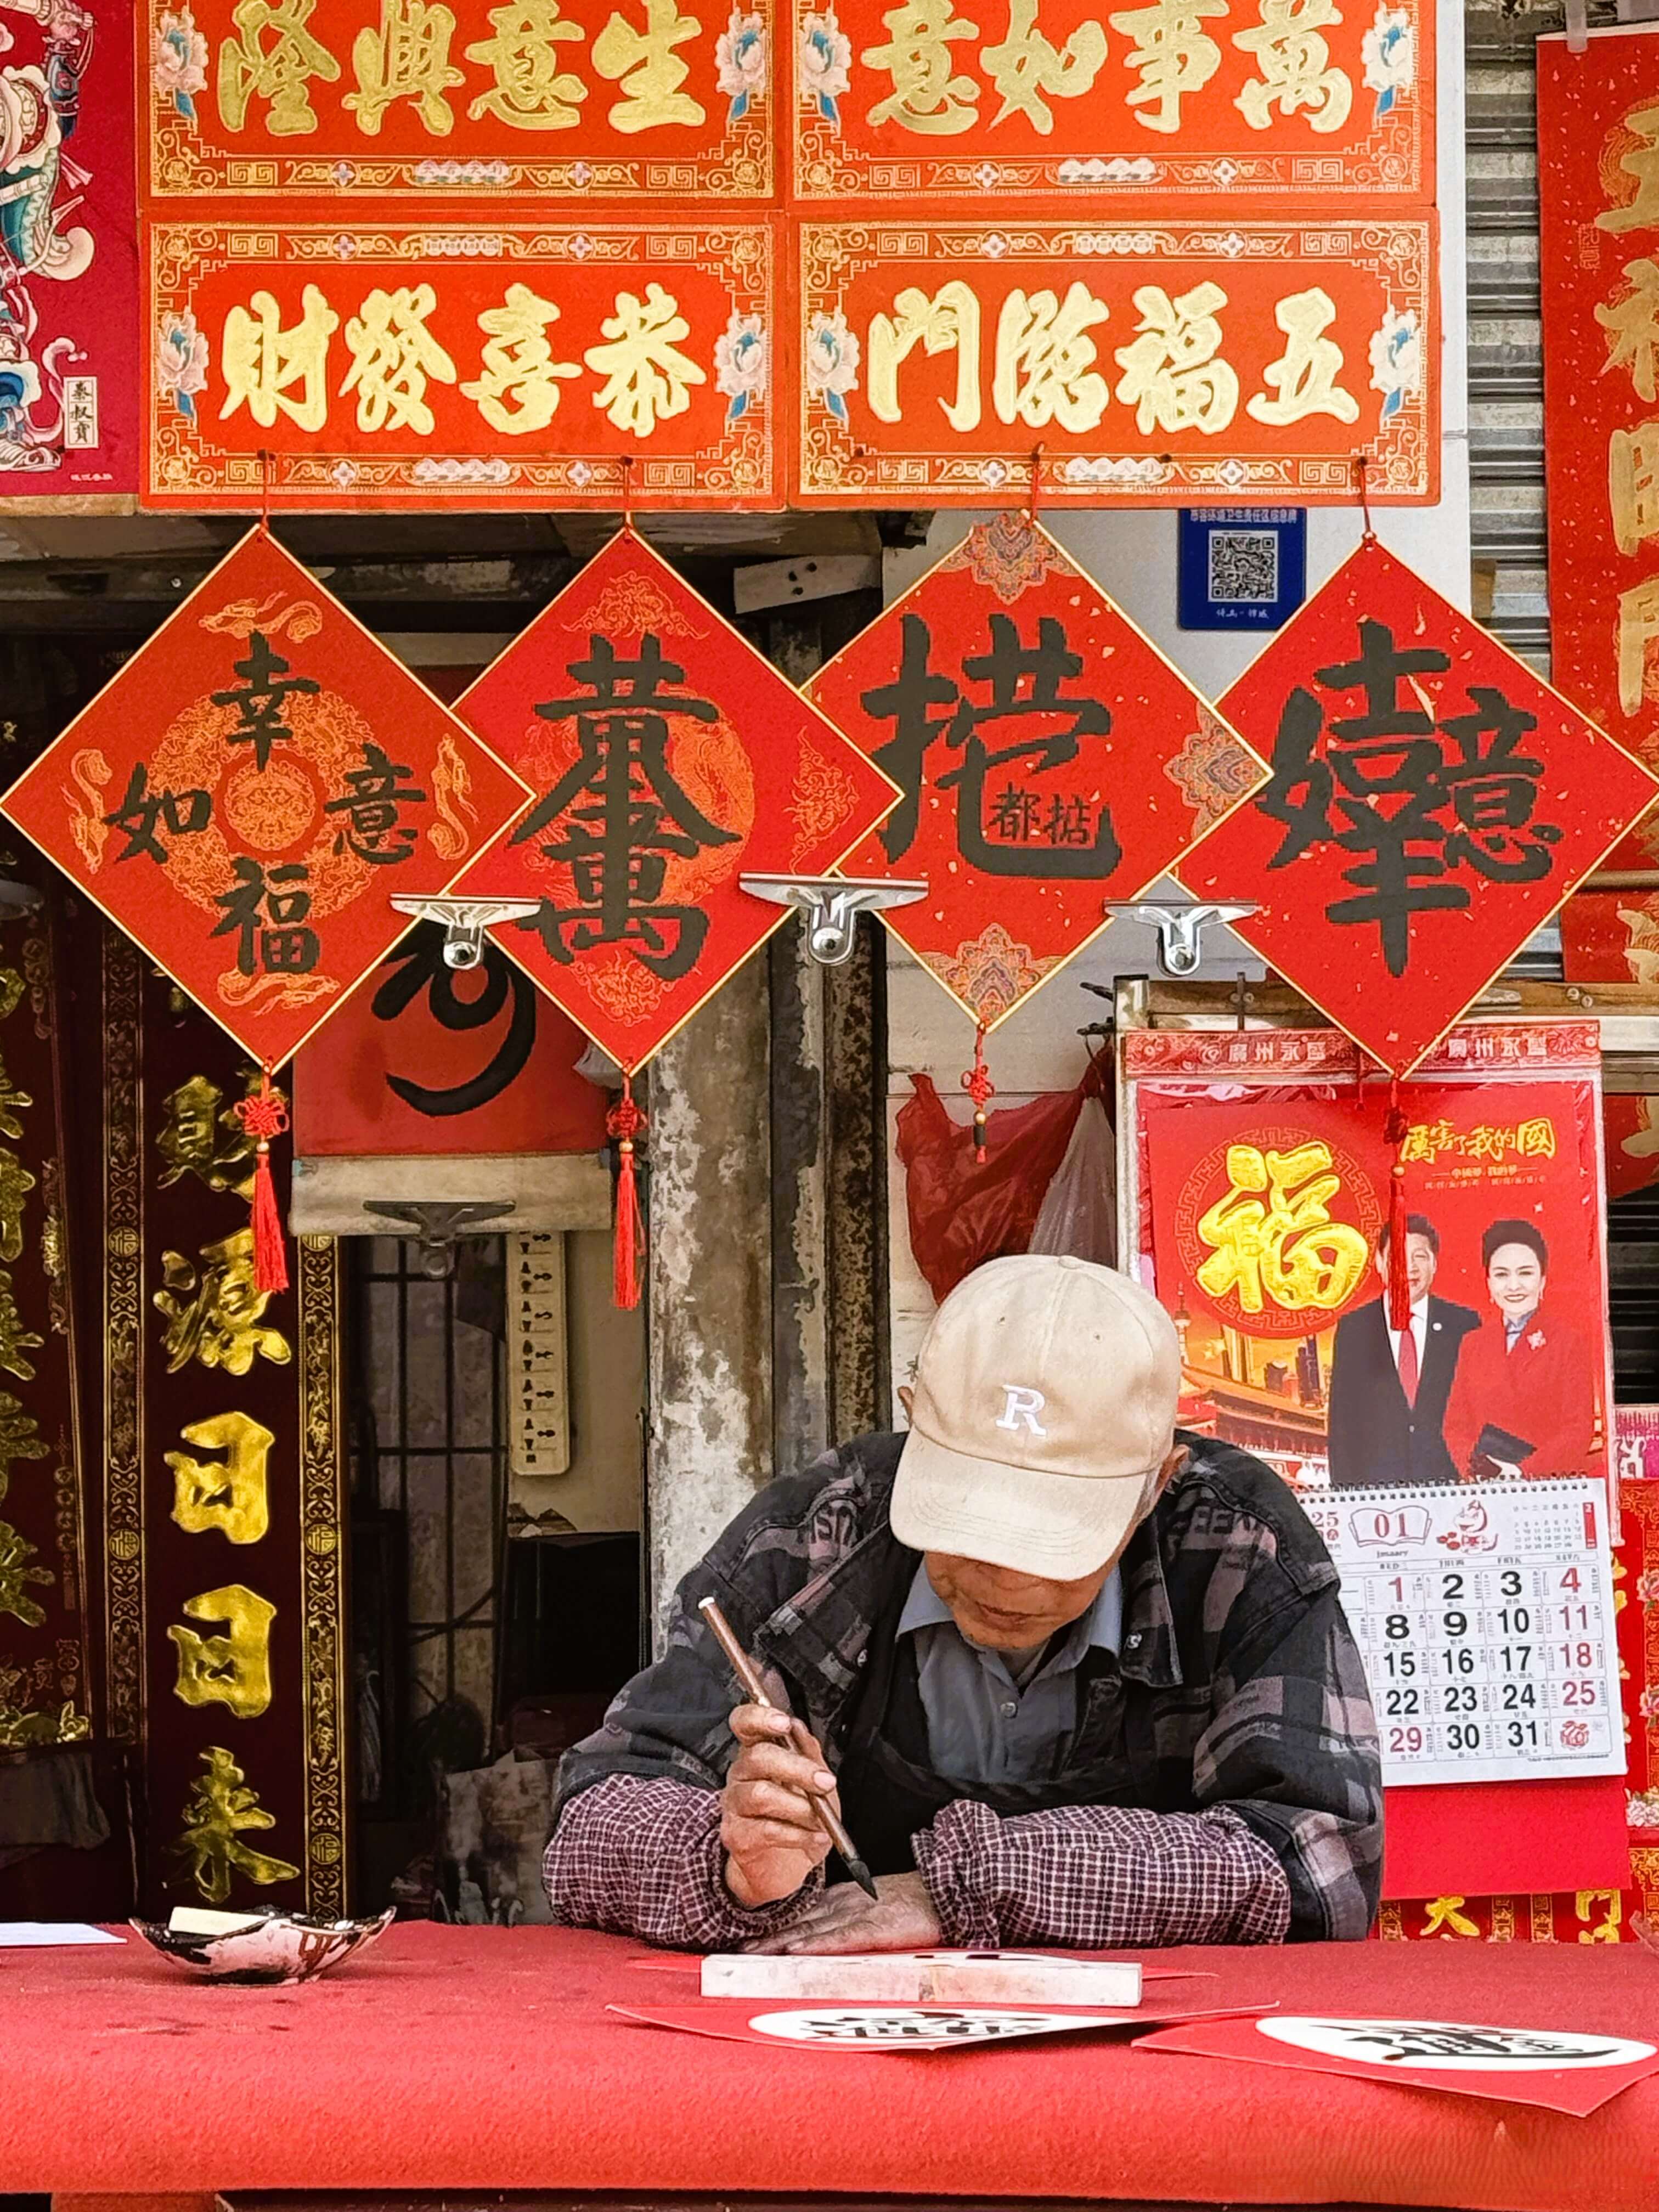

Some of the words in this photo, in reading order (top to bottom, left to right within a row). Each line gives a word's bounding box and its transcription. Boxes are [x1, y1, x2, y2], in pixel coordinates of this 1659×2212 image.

[1197, 1141, 1368, 1313] 福
[996, 1384, 1047, 1436] R
[1374, 1513, 1409, 1538] 01
[1388, 1577, 1403, 1602] 1
[1442, 1574, 1464, 1600] 2
[1500, 1571, 1522, 1596] 3
[1559, 1567, 1582, 1593] 4
[1385, 1614, 1410, 1640] 8
[1443, 1611, 1468, 1637] 9
[1497, 1607, 1530, 1634] 10
[1559, 1605, 1588, 1631] 11
[1384, 1651, 1416, 1677] 15
[1441, 1647, 1474, 1674] 16
[1500, 1646, 1532, 1672] 17
[1559, 1642, 1593, 1669] 18
[1386, 1689, 1419, 1716] 22
[1443, 1686, 1477, 1712] 23
[1502, 1683, 1536, 1710] 24
[1562, 1680, 1596, 1706] 25
[1389, 1726, 1422, 1753] 29
[1447, 1723, 1480, 1750] 30
[1508, 1720, 1537, 1747] 31
